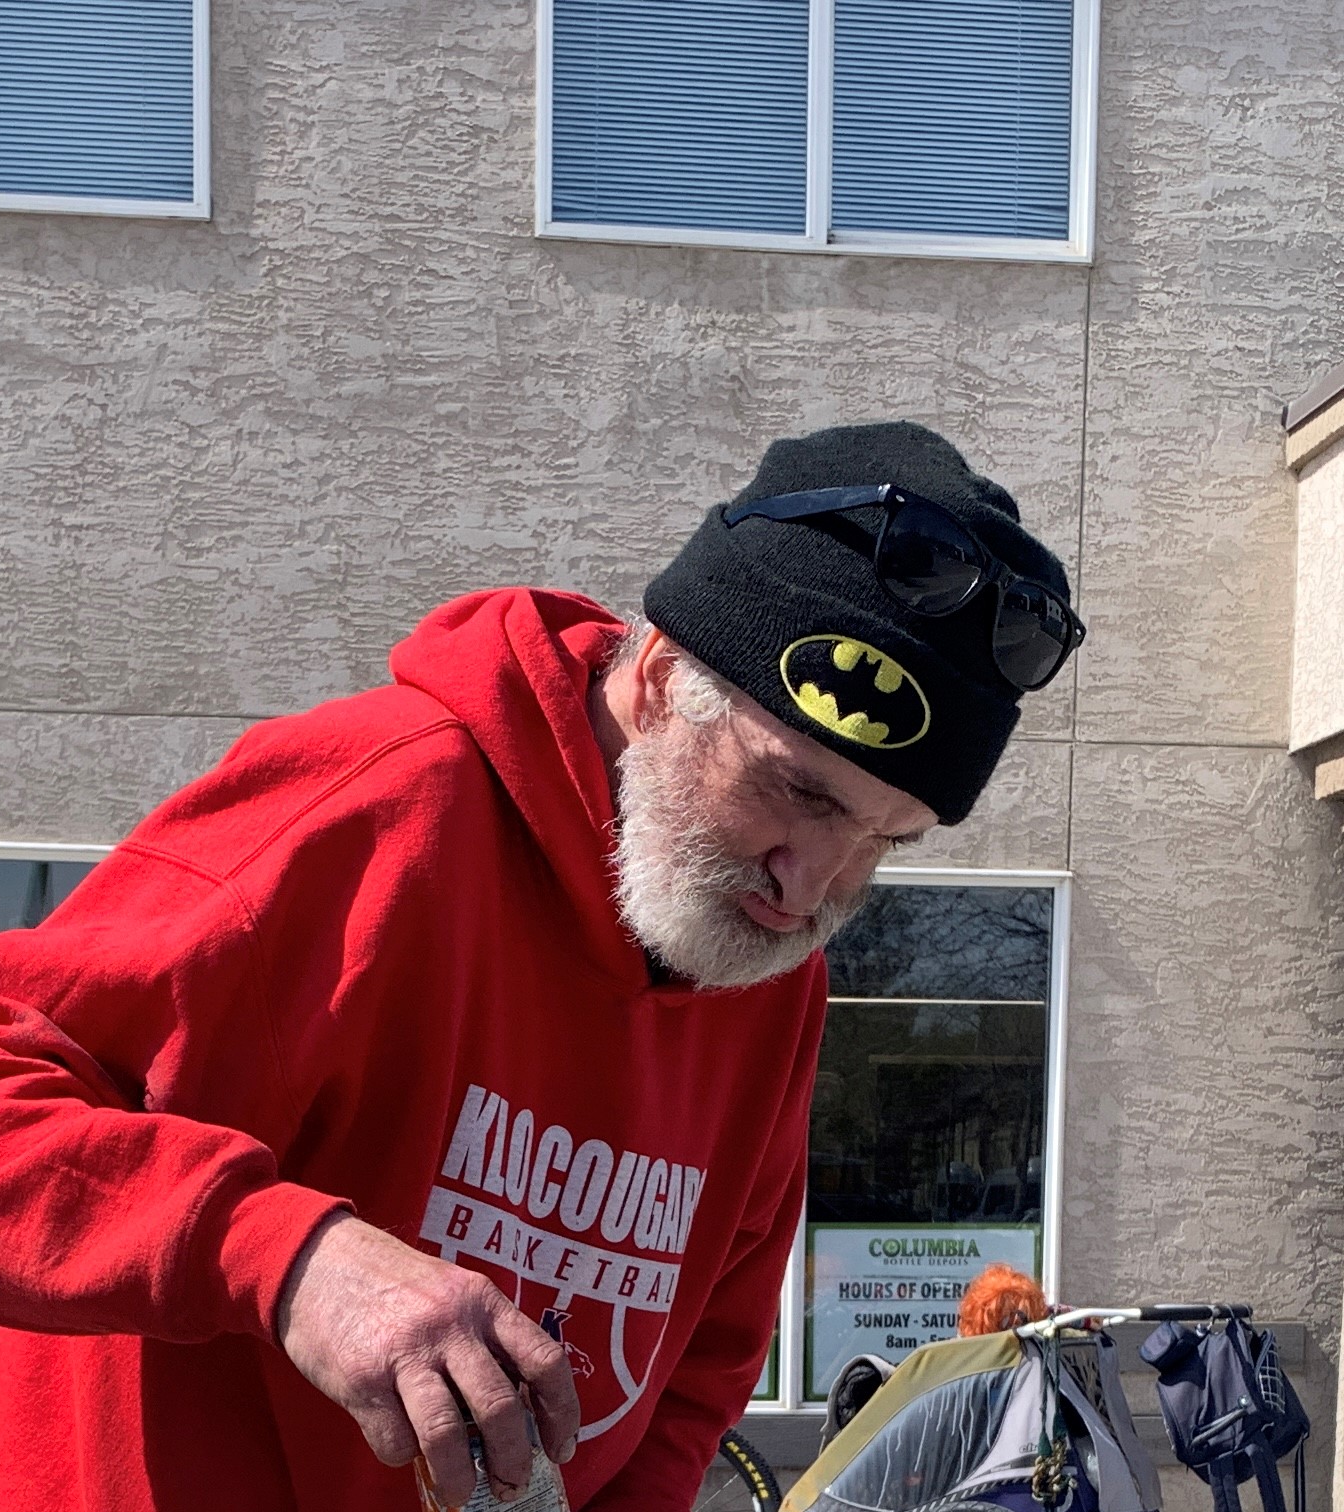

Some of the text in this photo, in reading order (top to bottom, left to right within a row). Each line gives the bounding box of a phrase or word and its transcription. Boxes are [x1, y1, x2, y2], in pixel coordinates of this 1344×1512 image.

[868, 1238, 981, 1258] COLUMBIA
[883, 1258, 922, 1266] BOTTLE
[838, 1282, 894, 1298] HOURS
[896, 1282, 916, 1298] OF
[854, 1314, 910, 1328] SUNDAY
[885, 1335, 917, 1348] 8am
